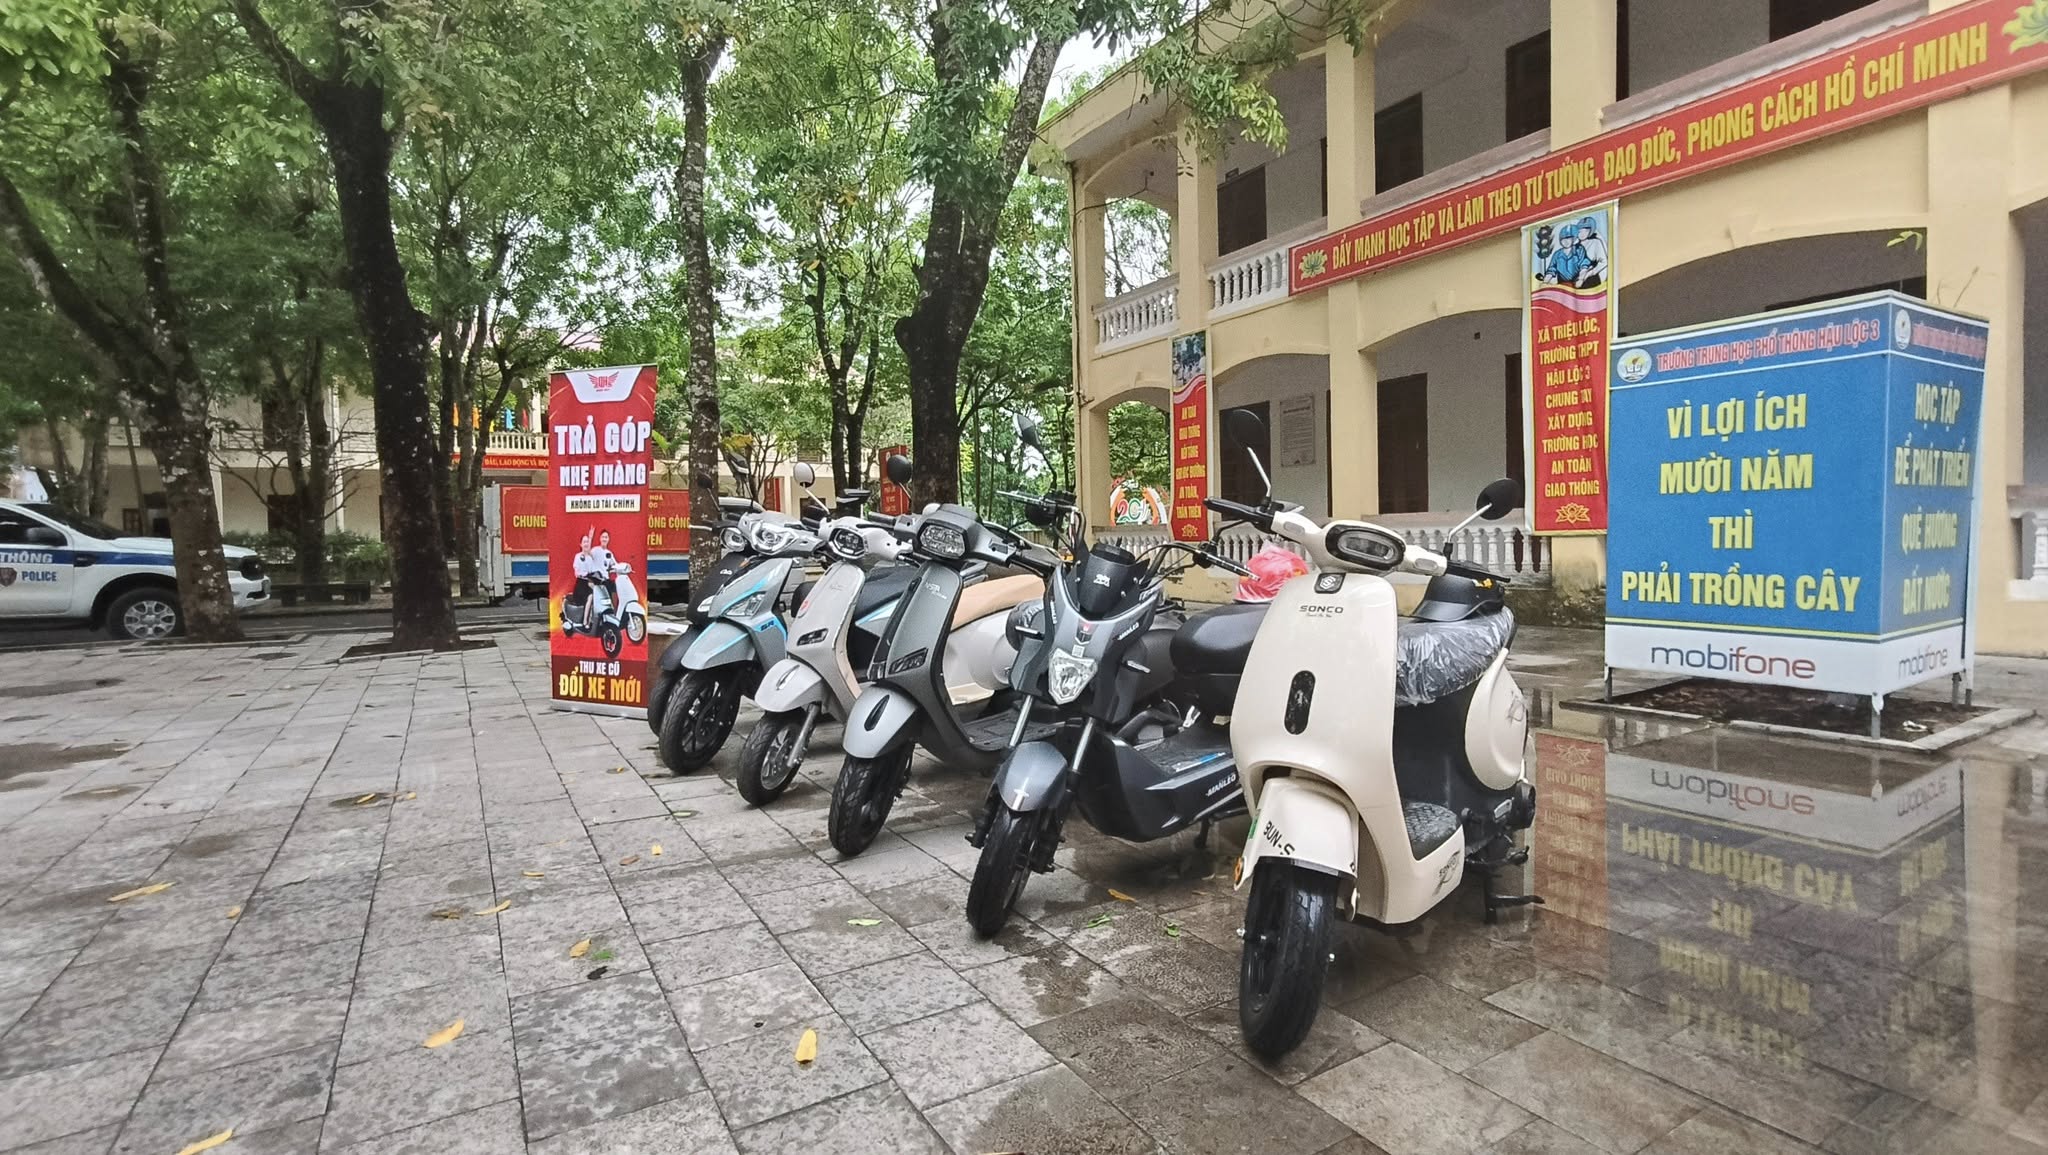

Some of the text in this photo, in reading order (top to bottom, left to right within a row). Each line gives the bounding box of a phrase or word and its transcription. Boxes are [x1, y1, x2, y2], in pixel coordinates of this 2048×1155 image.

[1333, 22, 1988, 270] ĐẨY MẠNH HỌC TẬP VÀ LÀM THEO TƯ TƯỞNG, ĐẠO ĐỨC, PHONG CÁCH HỒ CHÍ MINH
[1537, 325, 1550, 345] XÃ
[1552, 320, 1577, 341] TRIỆU
[1657, 318, 1880, 372] TRƯỜNG TRUNG HỌC PHỔ THÔNG HẬU LỘC 3
[1538, 343, 1576, 366] TRƯỜNG
[1546, 368, 1565, 389] HẬU
[1545, 392, 1579, 409] CHUNG
[1915, 380, 1961, 432] HỌC TẬP
[1547, 413, 1566, 431] XÂY
[1667, 391, 1807, 442] VÌ LỢI ÍCH
[554, 415, 651, 455] TRẢ GÓP
[1542, 434, 1580, 454] TRƯỜNG
[1551, 455, 1592, 475] AN TOÀN
[1659, 448, 1814, 495] MƯỜI NĂM
[1895, 432, 1970, 487] ĐỂ PHÁT TRIỂN
[559, 460, 646, 491] NHẸ NHÀNG
[1545, 477, 1600, 498] GIAO THÔNG
[613, 497, 634, 508] CHÍNH
[513, 515, 547, 528] CHUNG
[1708, 509, 1754, 550] THÌ
[1902, 506, 1922, 556] QUÊ
[0, 551, 53, 563] THÔNG
[22, 571, 57, 581] POLICE
[1621, 561, 1860, 613] PHẢI TRỒNG CÂY
[1299, 605, 1344, 614] SONCO
[579, 660, 620, 676] THU XE CŨ
[1651, 643, 1816, 680] mobifone
[1899, 646, 1948, 678] mobifone
[559, 665, 641, 703] ĐỔI XE MỚI
